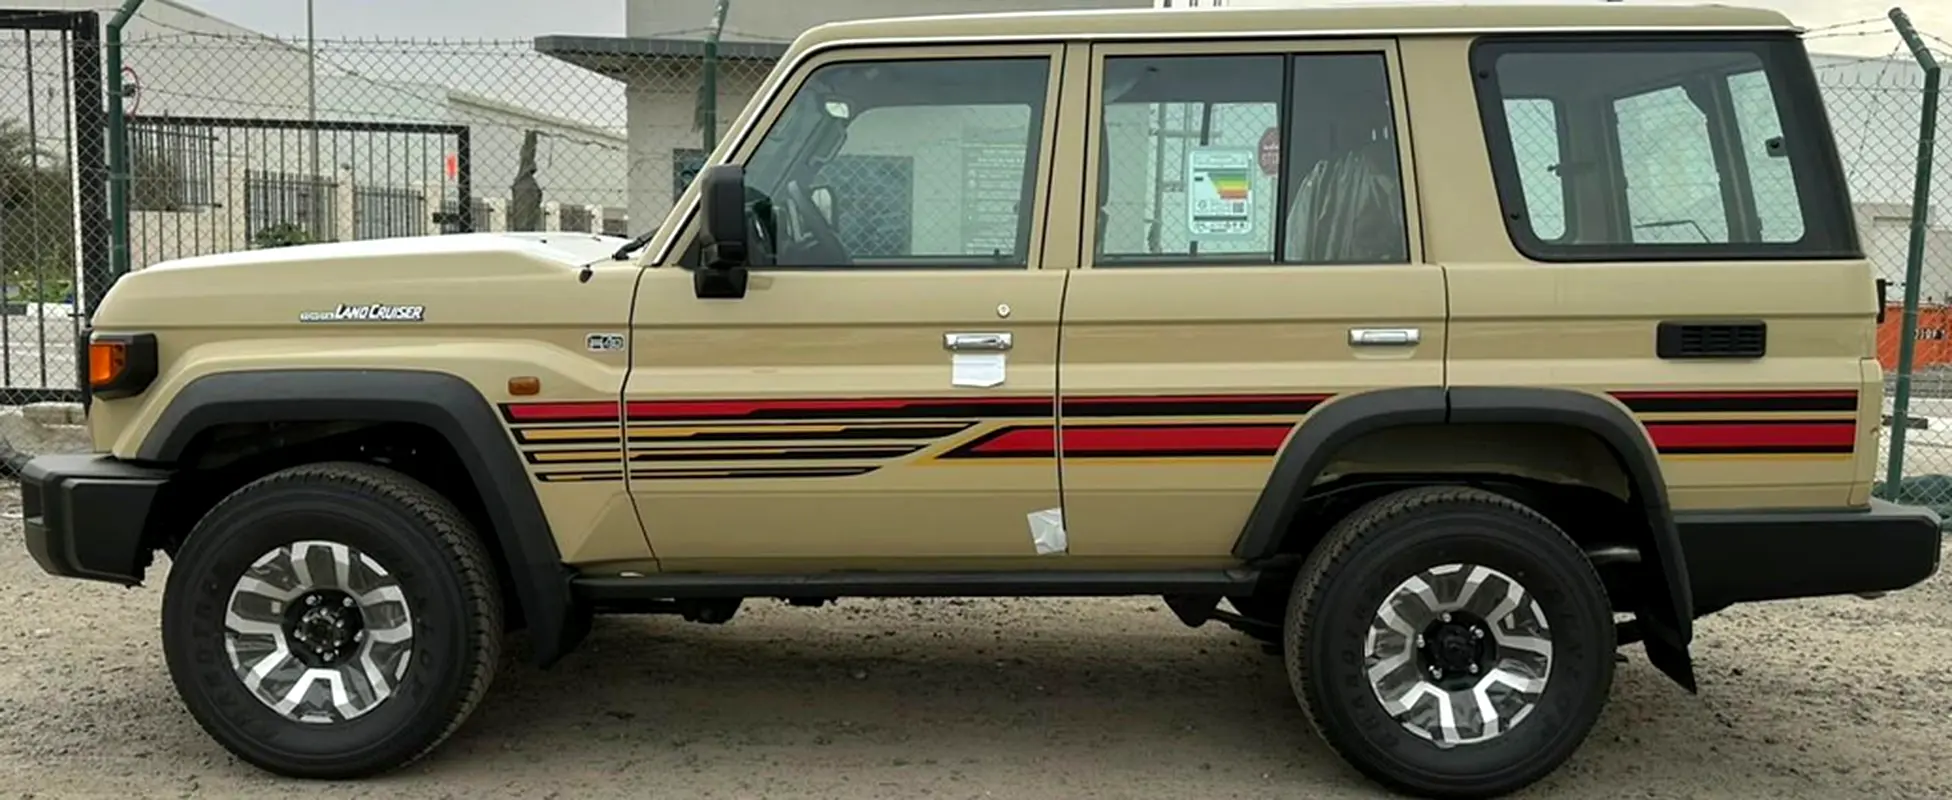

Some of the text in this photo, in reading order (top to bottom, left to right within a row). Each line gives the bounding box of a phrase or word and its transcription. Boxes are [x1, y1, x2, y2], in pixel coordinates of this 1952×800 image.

[1261, 151, 1280, 165] STO
[336, 304, 369, 320] LAND
[369, 304, 425, 320] CRUISER
